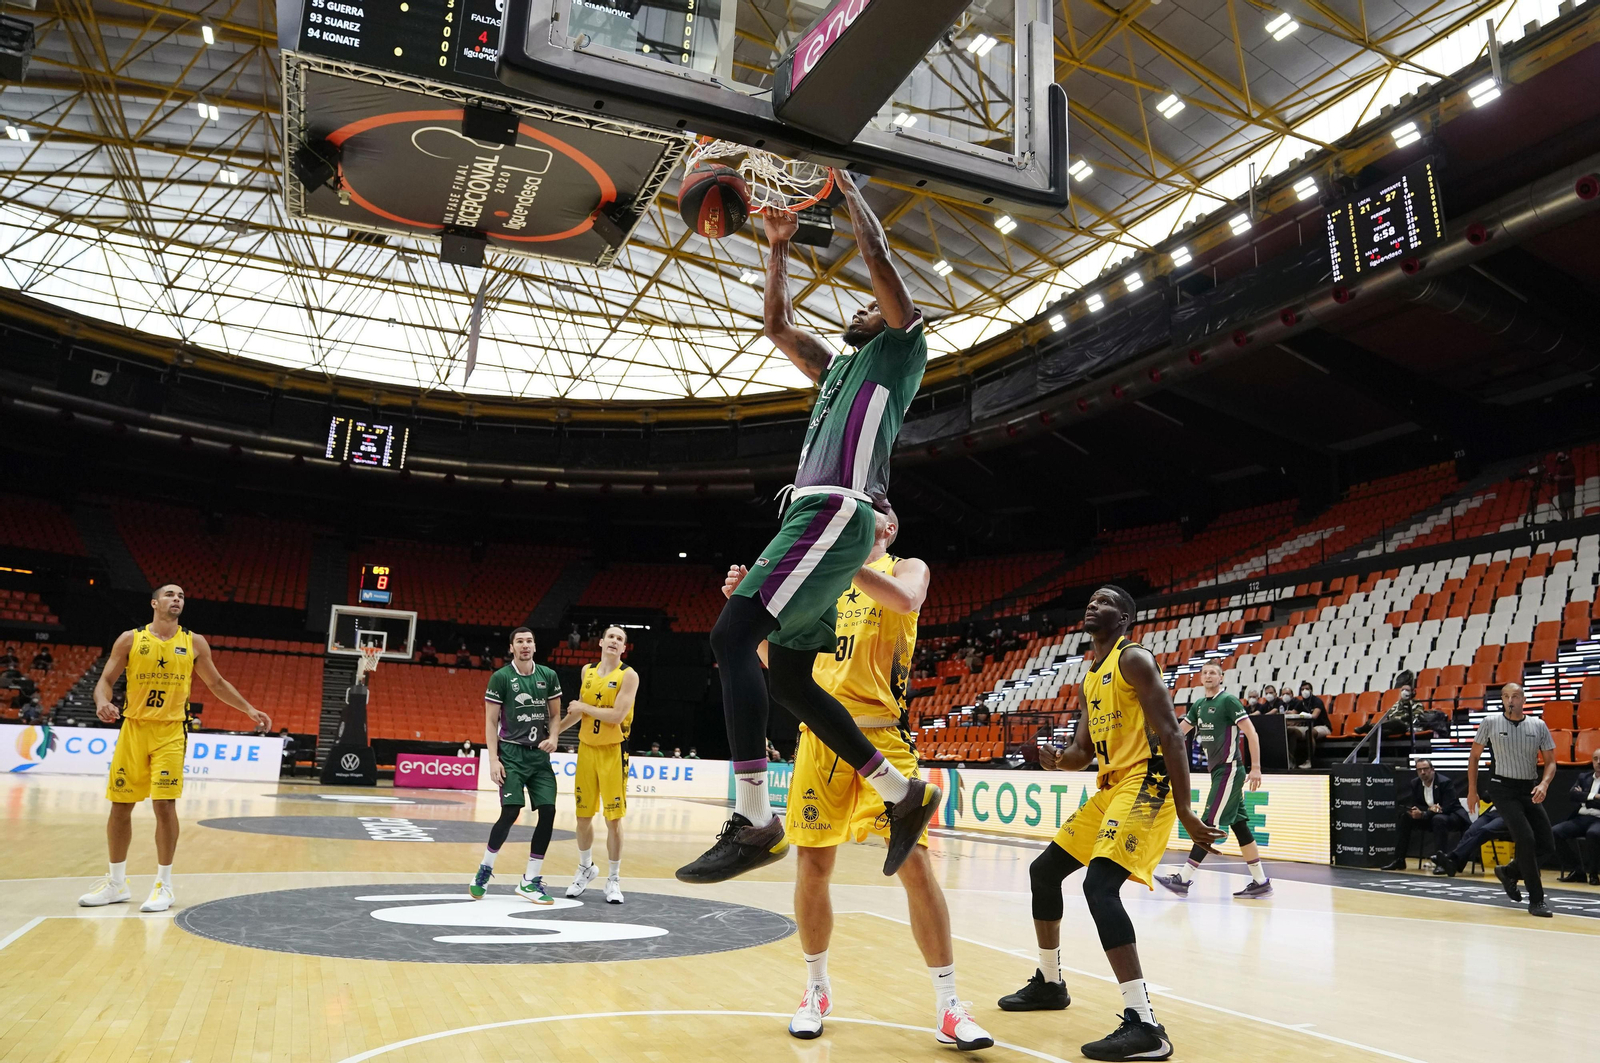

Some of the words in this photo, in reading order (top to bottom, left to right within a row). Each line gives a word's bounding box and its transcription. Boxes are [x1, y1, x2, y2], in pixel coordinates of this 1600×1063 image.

[327, 2, 364, 18] GUERRA
[688, 0, 694, 9] 3
[310, 12, 322, 24] 93
[325, 16, 361, 32] SUAREZ
[445, 12, 453, 22] 4
[471, 14, 502, 27] FALTAS
[686, 13, 693, 22] 0
[443, 26, 451, 38] 0
[478, 31, 488, 44] 4
[684, 26, 692, 36] 0
[308, 28, 320, 38] 94
[322, 32, 360, 48] KONATE
[441, 41, 448, 52] 0
[684, 40, 690, 50] 6
[439, 56, 447, 66] 0
[682, 53, 688, 63] 0
[452, 164, 470, 190] FINAL
[494, 172, 511, 194] 2020
[455, 155, 500, 228] EXCEPCIONAL
[1386, 191, 1396, 202] 27
[446, 193, 460, 212] FASE
[1360, 204, 1370, 214] 21
[1378, 216, 1382, 224] 2
[1373, 226, 1396, 242] 6:58
[1530, 529, 1545, 542] 111
[377, 576, 388, 590] 8
[1249, 582, 1260, 590] 112
[851, 619, 880, 628] RESORTS
[835, 634, 854, 662] 31
[136, 672, 186, 680] IBEROSTAR
[146, 690, 166, 708] 25
[593, 719, 600, 734] 9
[528, 726, 538, 742] 8
[186, 742, 260, 762] DEJE
[184, 765, 209, 774] SUR
[400, 759, 475, 776] endesa
[628, 765, 694, 781] ADEJE
[636, 785, 656, 793] SUR
[801, 822, 832, 830] LAGUNA
